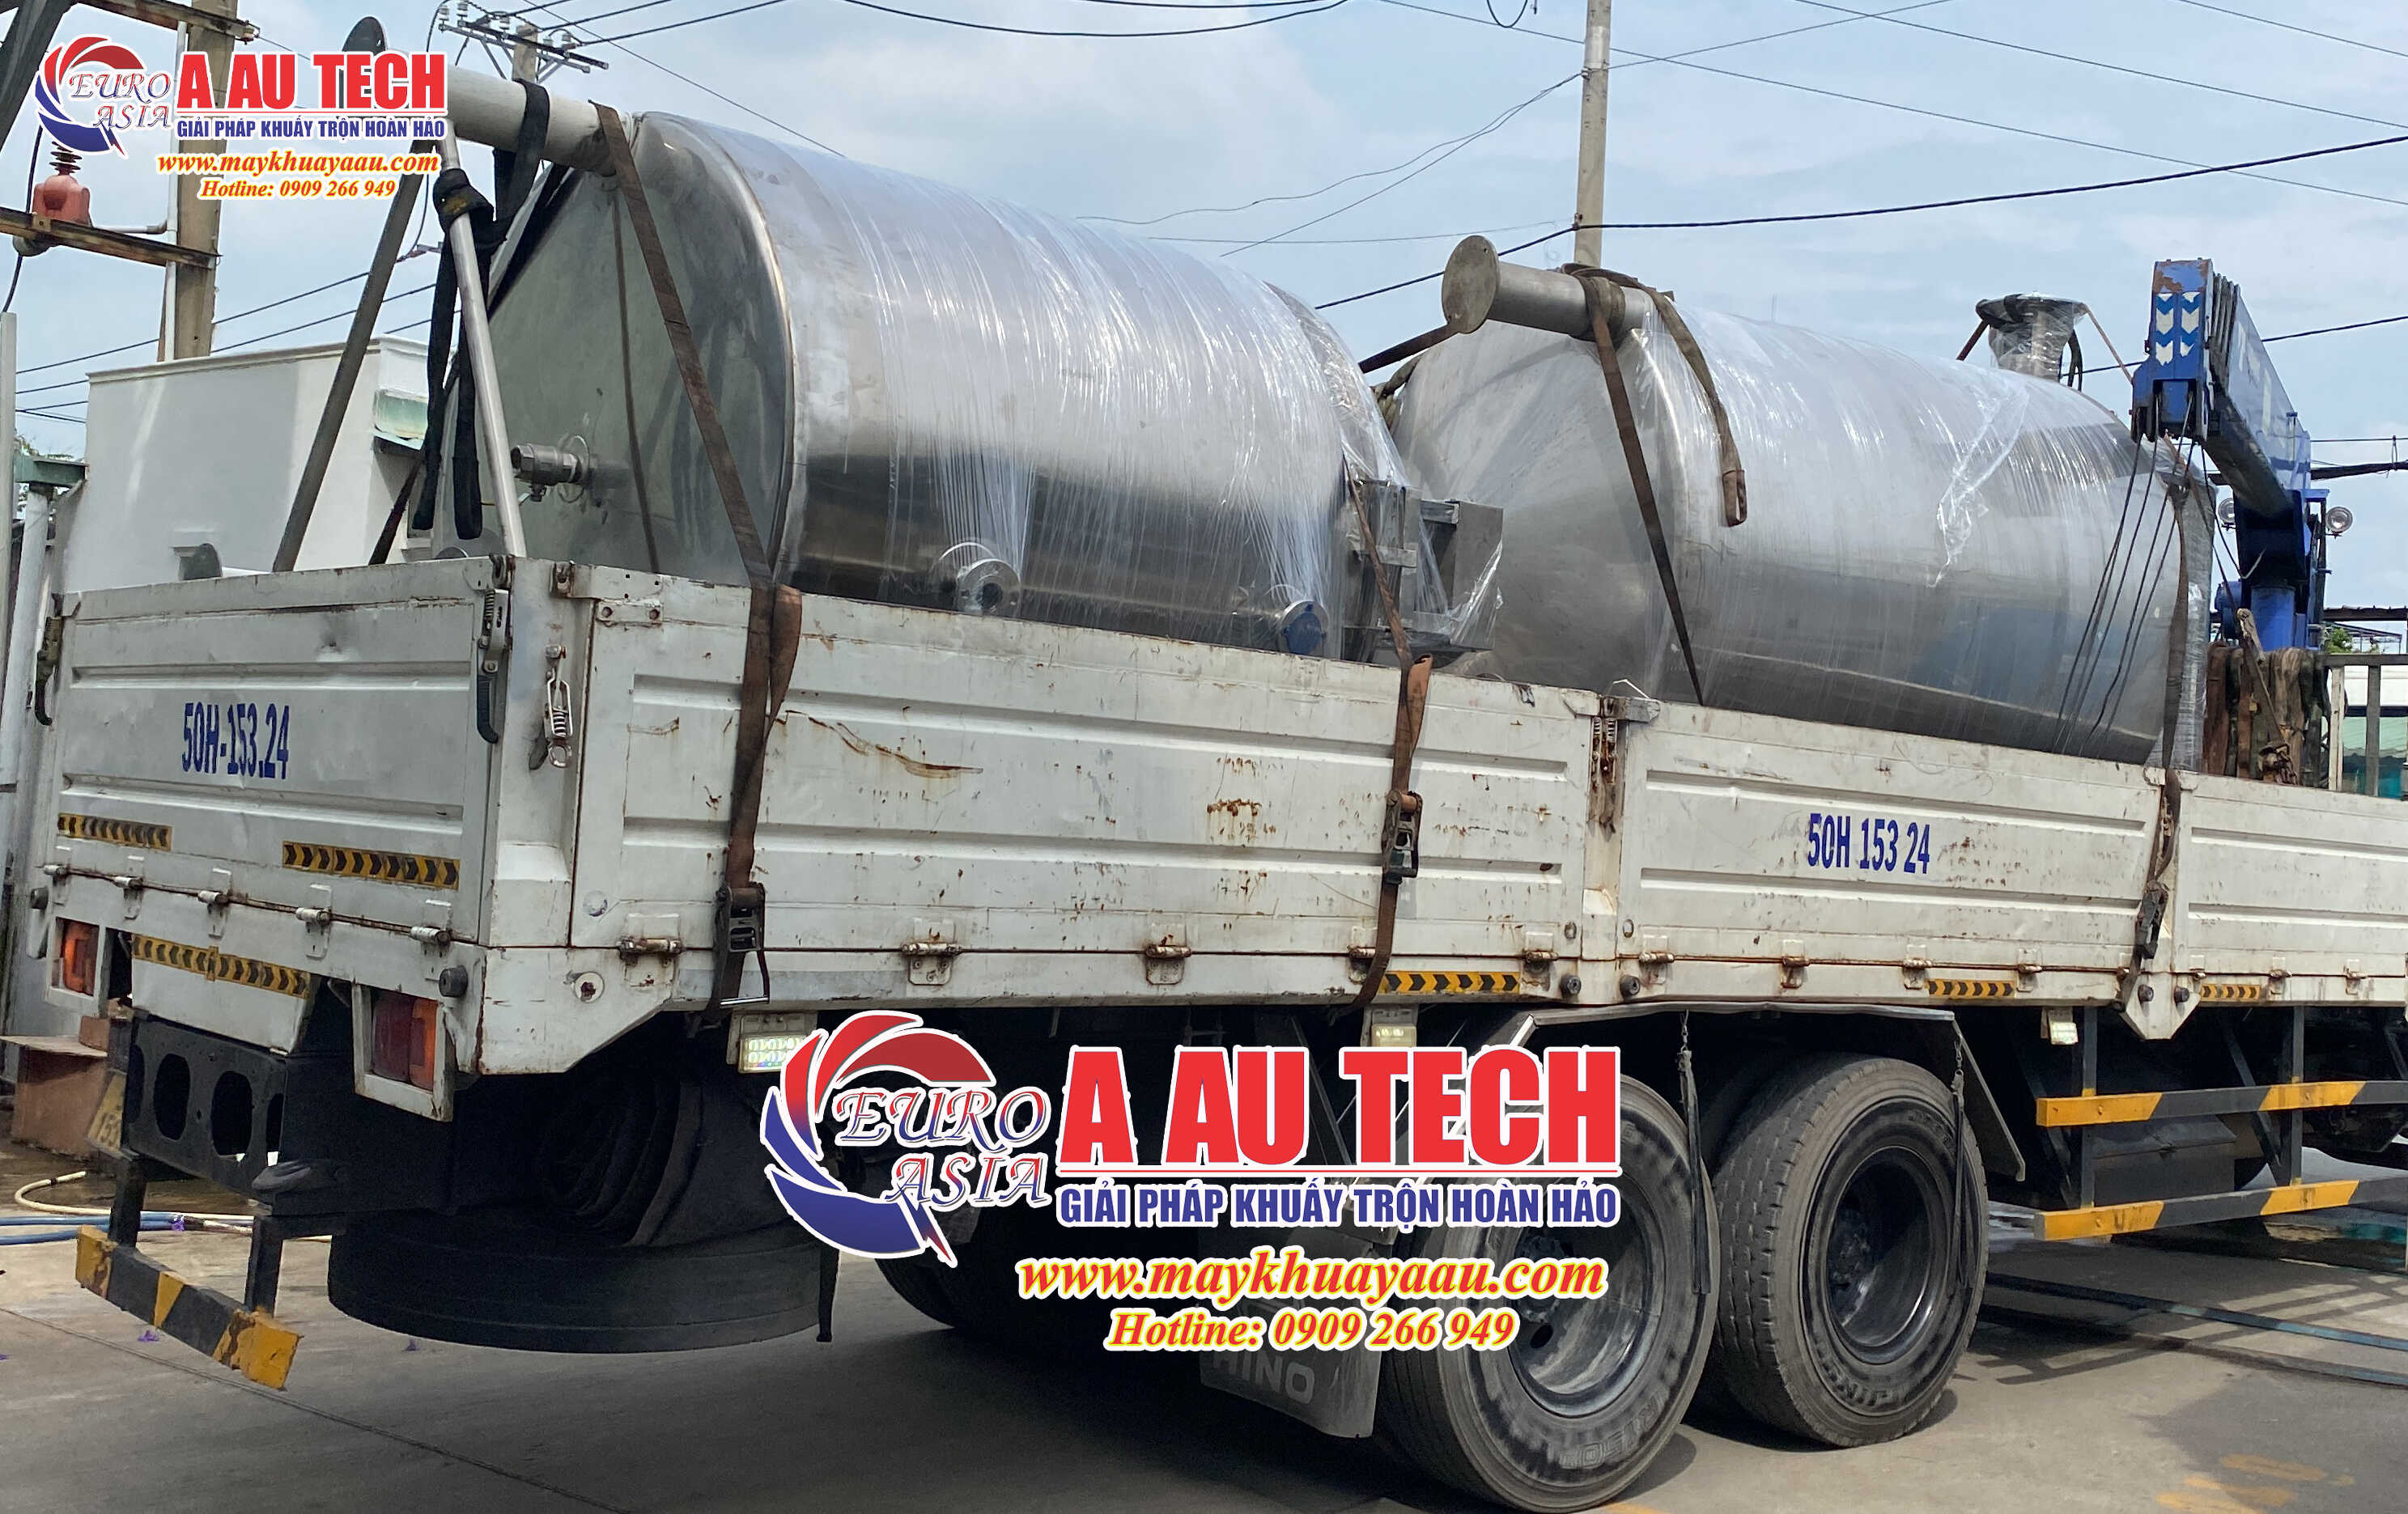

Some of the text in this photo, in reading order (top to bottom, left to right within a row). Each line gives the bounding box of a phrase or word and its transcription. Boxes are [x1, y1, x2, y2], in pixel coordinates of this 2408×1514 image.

[182, 702, 290, 780] 50H-153.24
[1807, 812, 1930, 875] 50H 153 24
